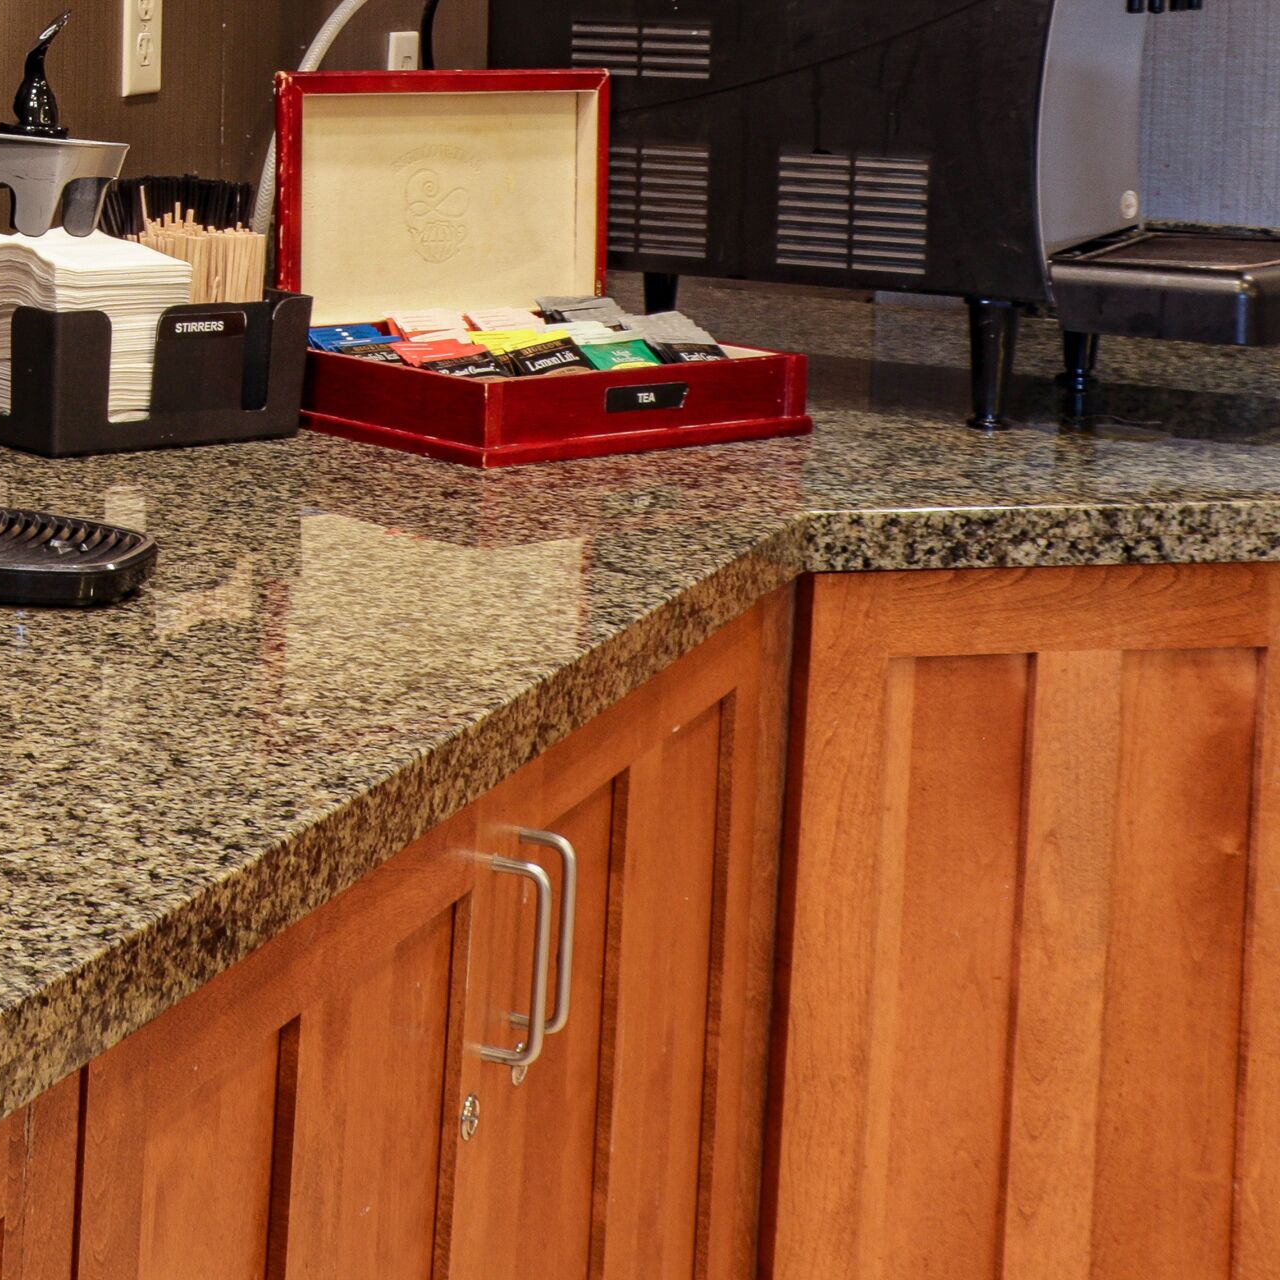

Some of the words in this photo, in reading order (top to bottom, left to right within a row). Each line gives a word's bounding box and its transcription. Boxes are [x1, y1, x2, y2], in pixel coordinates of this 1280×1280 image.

[175, 320, 225, 333] STIRRERS
[525, 356, 561, 372] Lemon
[636, 393, 656, 404] TEA
